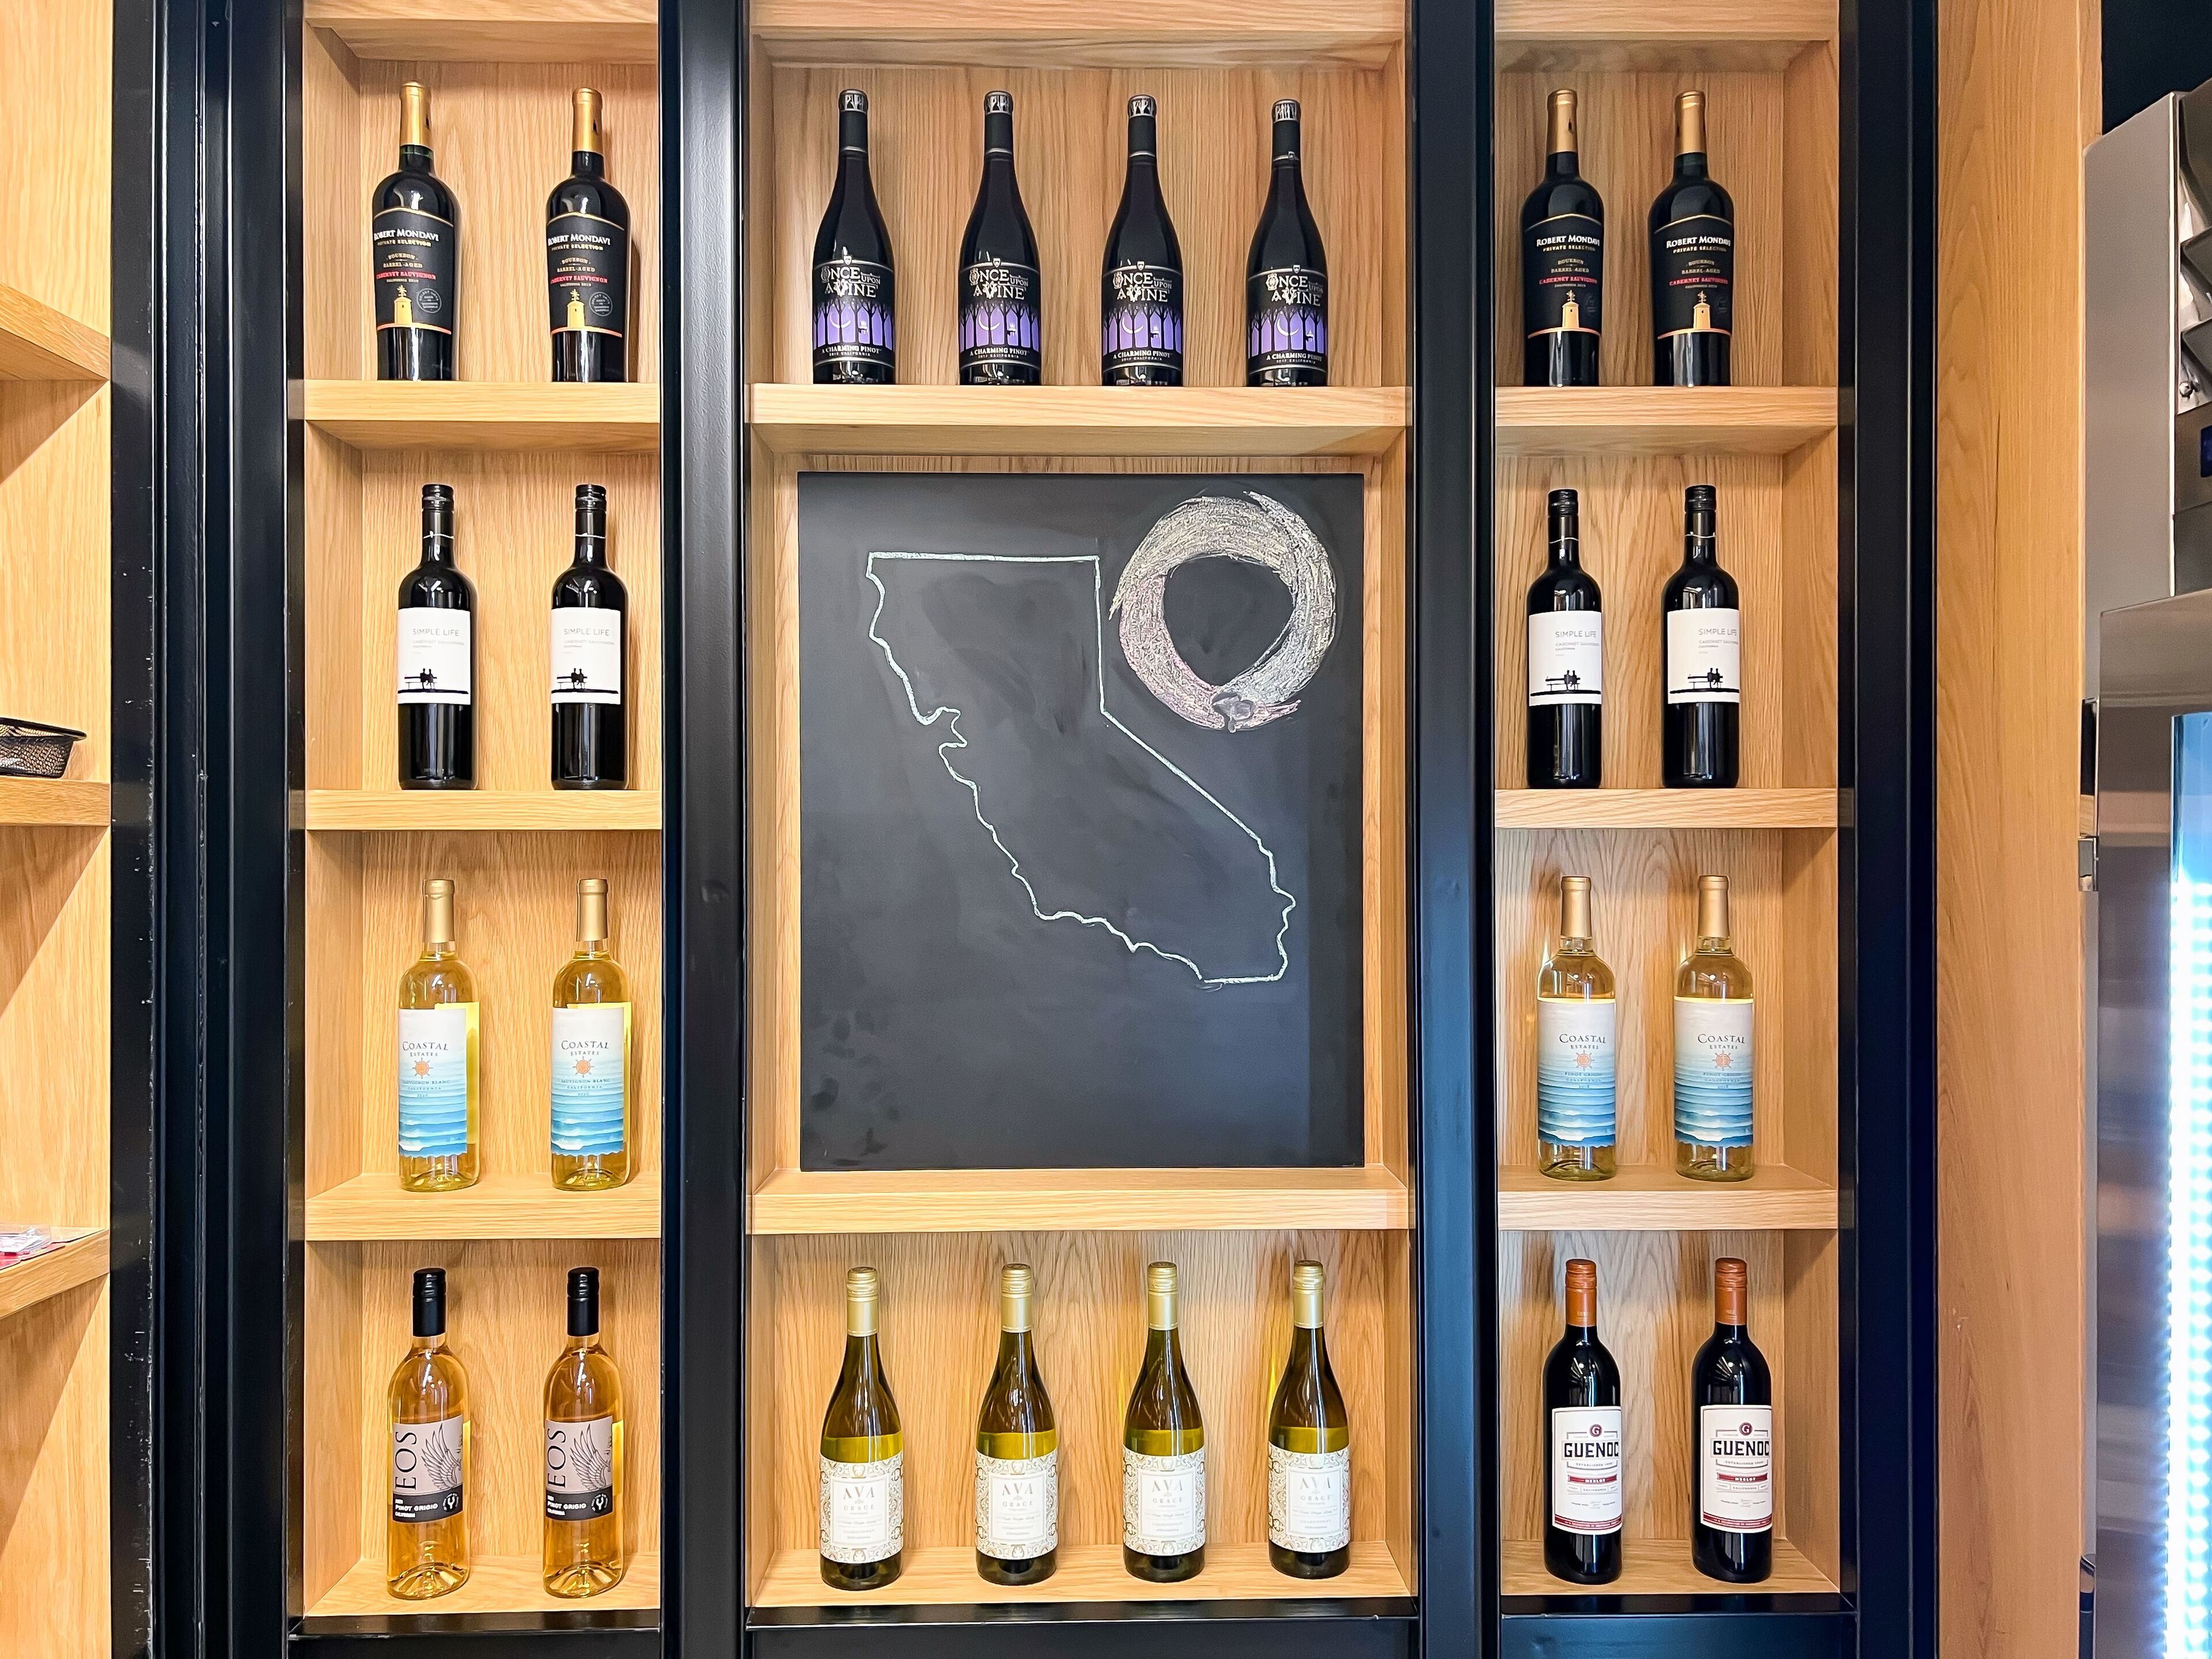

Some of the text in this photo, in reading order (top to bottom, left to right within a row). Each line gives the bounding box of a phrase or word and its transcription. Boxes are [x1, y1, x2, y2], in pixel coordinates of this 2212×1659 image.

[397, 229, 439, 241] MONDAVI
[548, 234, 610, 245] ROBERT MONDAVI
[1537, 235, 1600, 247] ROBERT MONDAVI
[1666, 236, 1730, 248] ROBERT MONDAVI
[821, 266, 880, 285] ONCE UPON
[969, 268, 1028, 286] ONCE UPON
[1113, 271, 1172, 289] ONCE UPON
[1266, 273, 1308, 290] ONCE
[1669, 278, 1699, 286] CABERNET
[825, 279, 876, 298] A VINE
[974, 281, 1024, 300] A VINE
[1117, 285, 1168, 302] A VINE
[1271, 287, 1320, 306] A VINE
[861, 345, 880, 354] PINOT
[1118, 350, 1152, 358] CHARMING
[1559, 1033, 1606, 1044] COASTAL
[1698, 1033, 1745, 1044] COASTAL
[403, 1041, 448, 1051] COASTAL
[561, 1040, 608, 1050] COASTAL
[1591, 1426, 1600, 1435] G
[1741, 1425, 1750, 1434] G
[1565, 1442, 1619, 1457] GUENOC
[1713, 1441, 1769, 1456] GUENOC
[395, 1431, 416, 1490] EOS
[547, 1429, 566, 1488] EOS
[1002, 1483, 1033, 1495] AVA
[1152, 1479, 1183, 1492] AVA
[843, 1486, 874, 1499] AVA
[414, 1503, 438, 1512] GRIGIO
